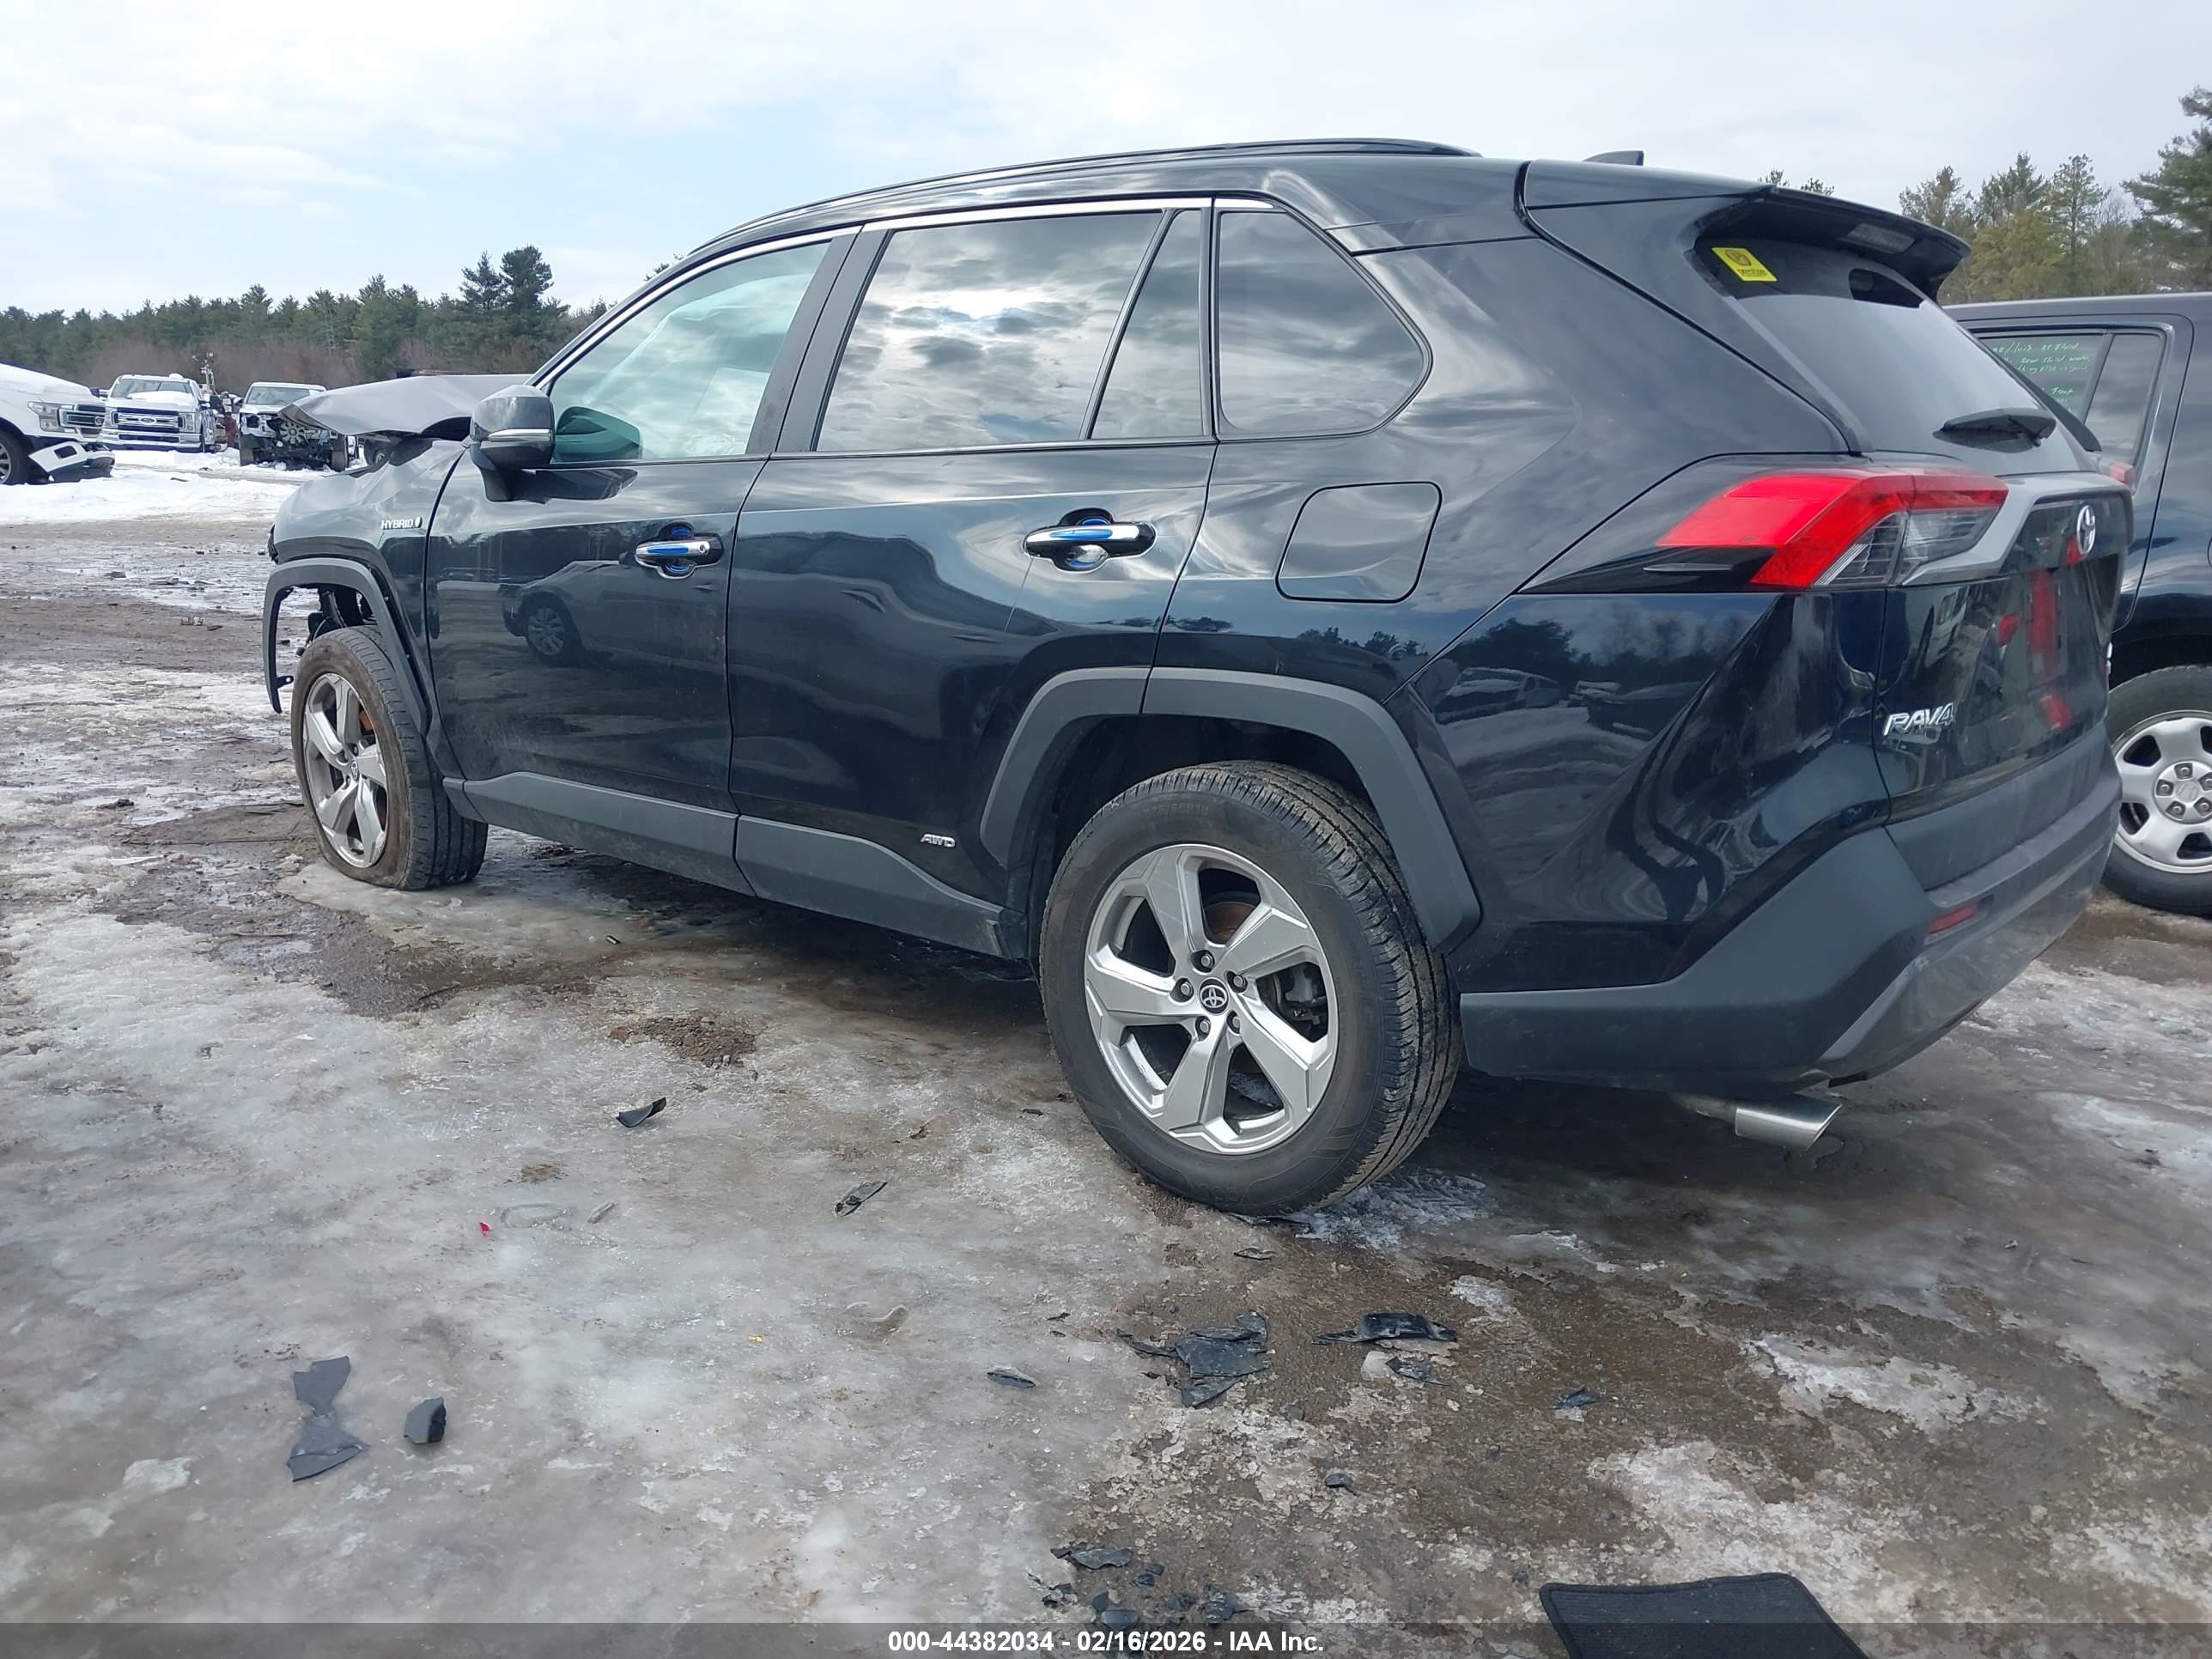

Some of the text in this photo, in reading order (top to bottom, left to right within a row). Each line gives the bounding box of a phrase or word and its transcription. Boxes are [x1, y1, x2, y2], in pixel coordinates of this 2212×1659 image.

[380, 519, 414, 530] HYBRID
[1883, 702, 1954, 737] RAV4
[921, 833, 956, 848] AWD
